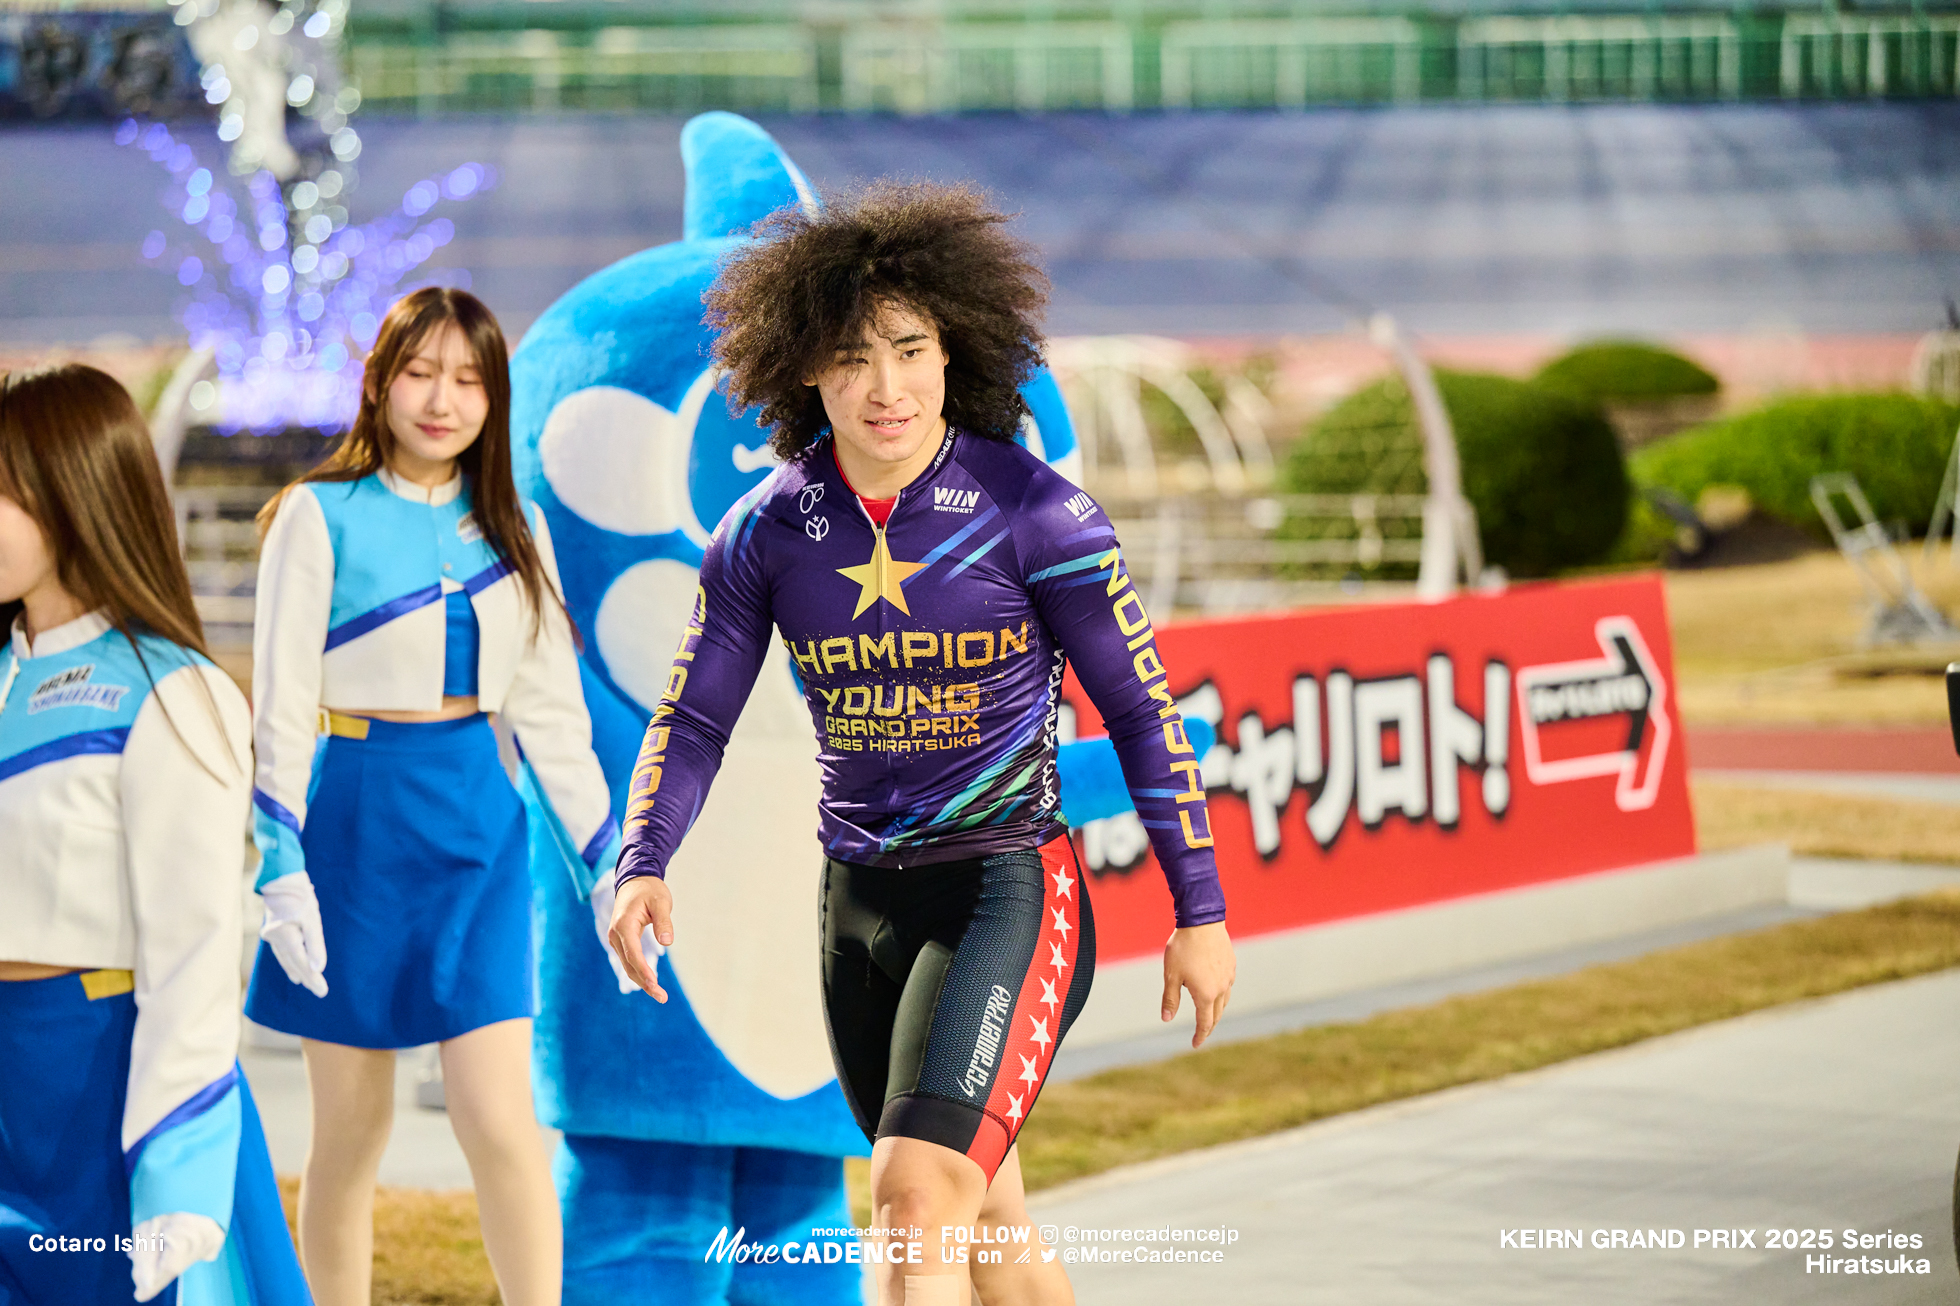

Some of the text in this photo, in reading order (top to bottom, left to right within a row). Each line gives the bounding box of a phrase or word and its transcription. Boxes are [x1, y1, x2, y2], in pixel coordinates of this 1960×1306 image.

[934, 487, 980, 508] WIN
[934, 505, 975, 514] WINTICKET
[783, 621, 1029, 675] HAMPION
[816, 683, 981, 717] YOUNG
[1099, 547, 1214, 849] CHAMPION
[825, 713, 981, 737] GRAND PRIX
[827, 732, 981, 753] 2025 HIRATSUKA
